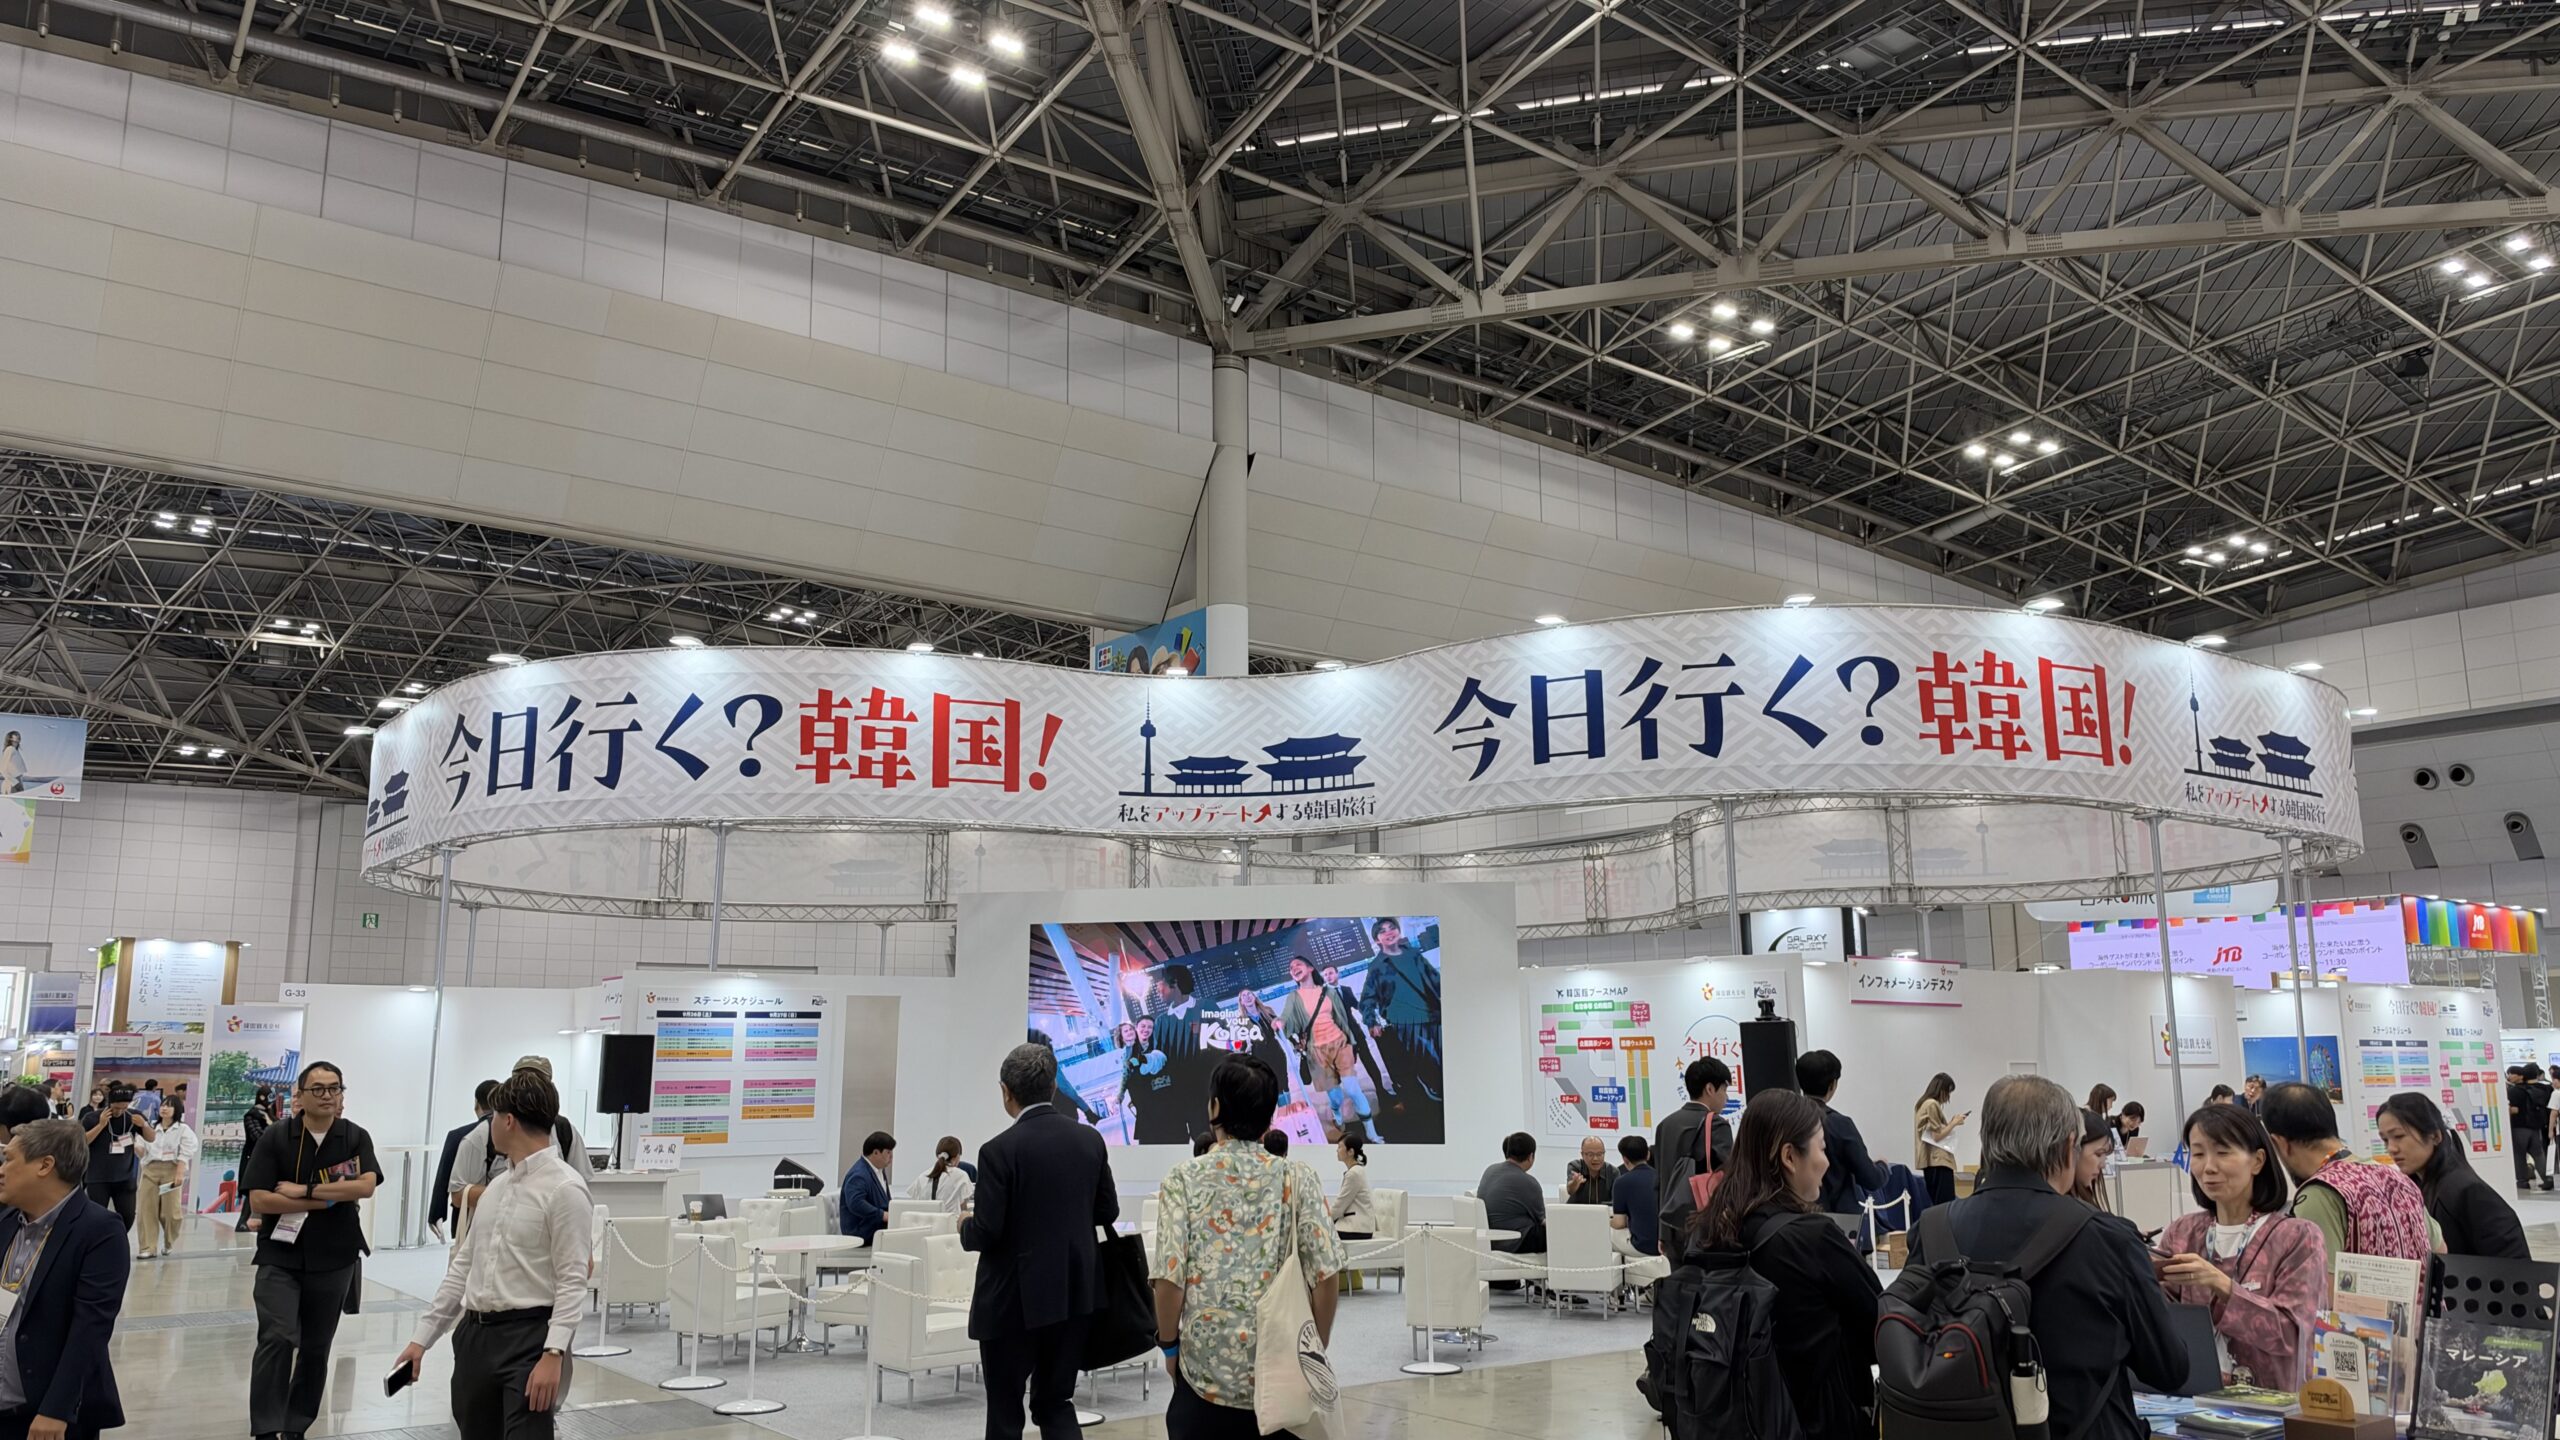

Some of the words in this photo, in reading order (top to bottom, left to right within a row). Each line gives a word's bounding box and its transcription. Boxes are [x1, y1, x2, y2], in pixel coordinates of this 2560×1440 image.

[1433, 649, 2136, 782] 今日行く?韓国!
[439, 686, 1064, 811] 今日行く?韓国!
[1787, 934, 1827, 943] GALAXY
[2213, 946, 2243, 966] JTB
[1859, 974, 1954, 992] インフォメーションデスク
[285, 989, 306, 997] G-33
[693, 995, 783, 1006] ステージスケジュール
[1753, 987, 1777, 999] Korea
[1226, 1017, 1250, 1027] your
[1200, 1022, 1264, 1050] Korea
[1683, 1036, 1743, 1058] 今日行く
[2446, 1348, 2527, 1368] マレーシア
